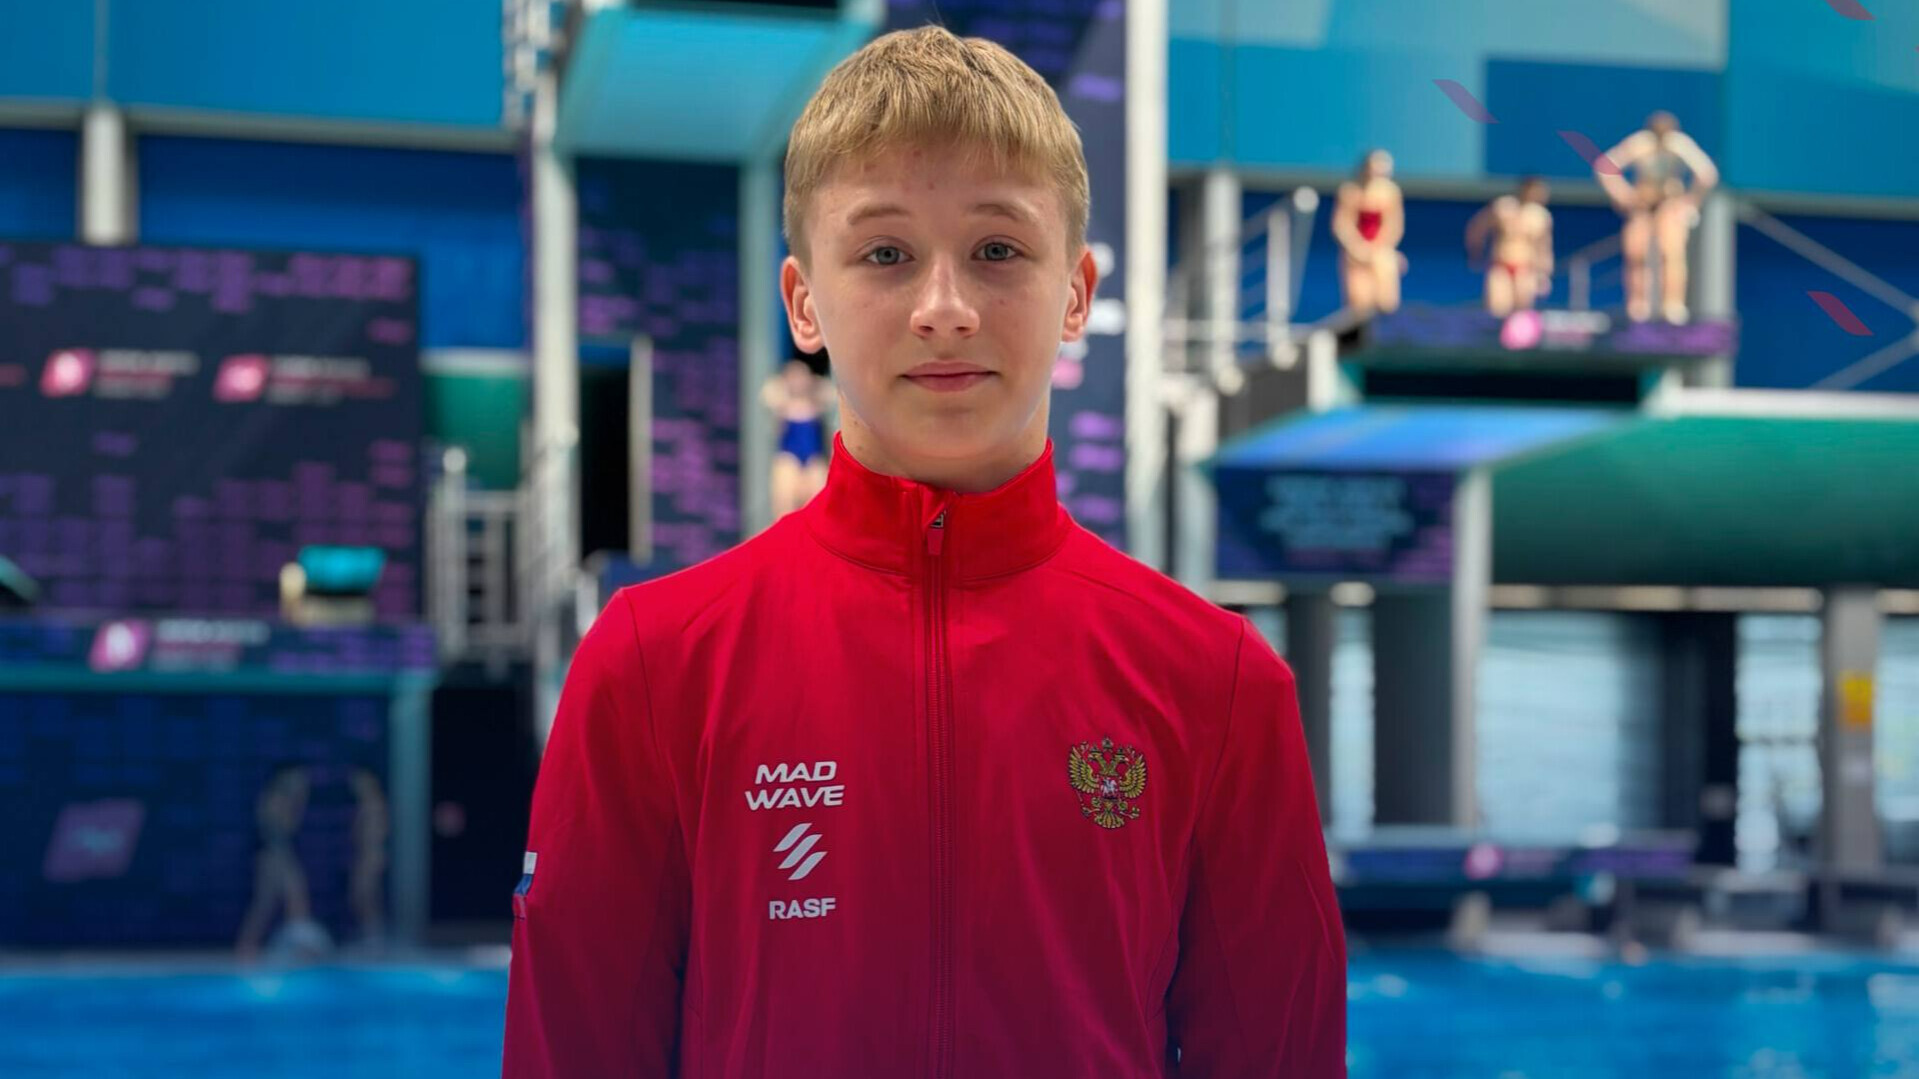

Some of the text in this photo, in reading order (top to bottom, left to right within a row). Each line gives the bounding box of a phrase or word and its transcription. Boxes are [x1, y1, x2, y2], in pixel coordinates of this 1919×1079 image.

[755, 761, 837, 785] MAD
[745, 785, 845, 811] WAVE
[769, 898, 836, 920] RASF
